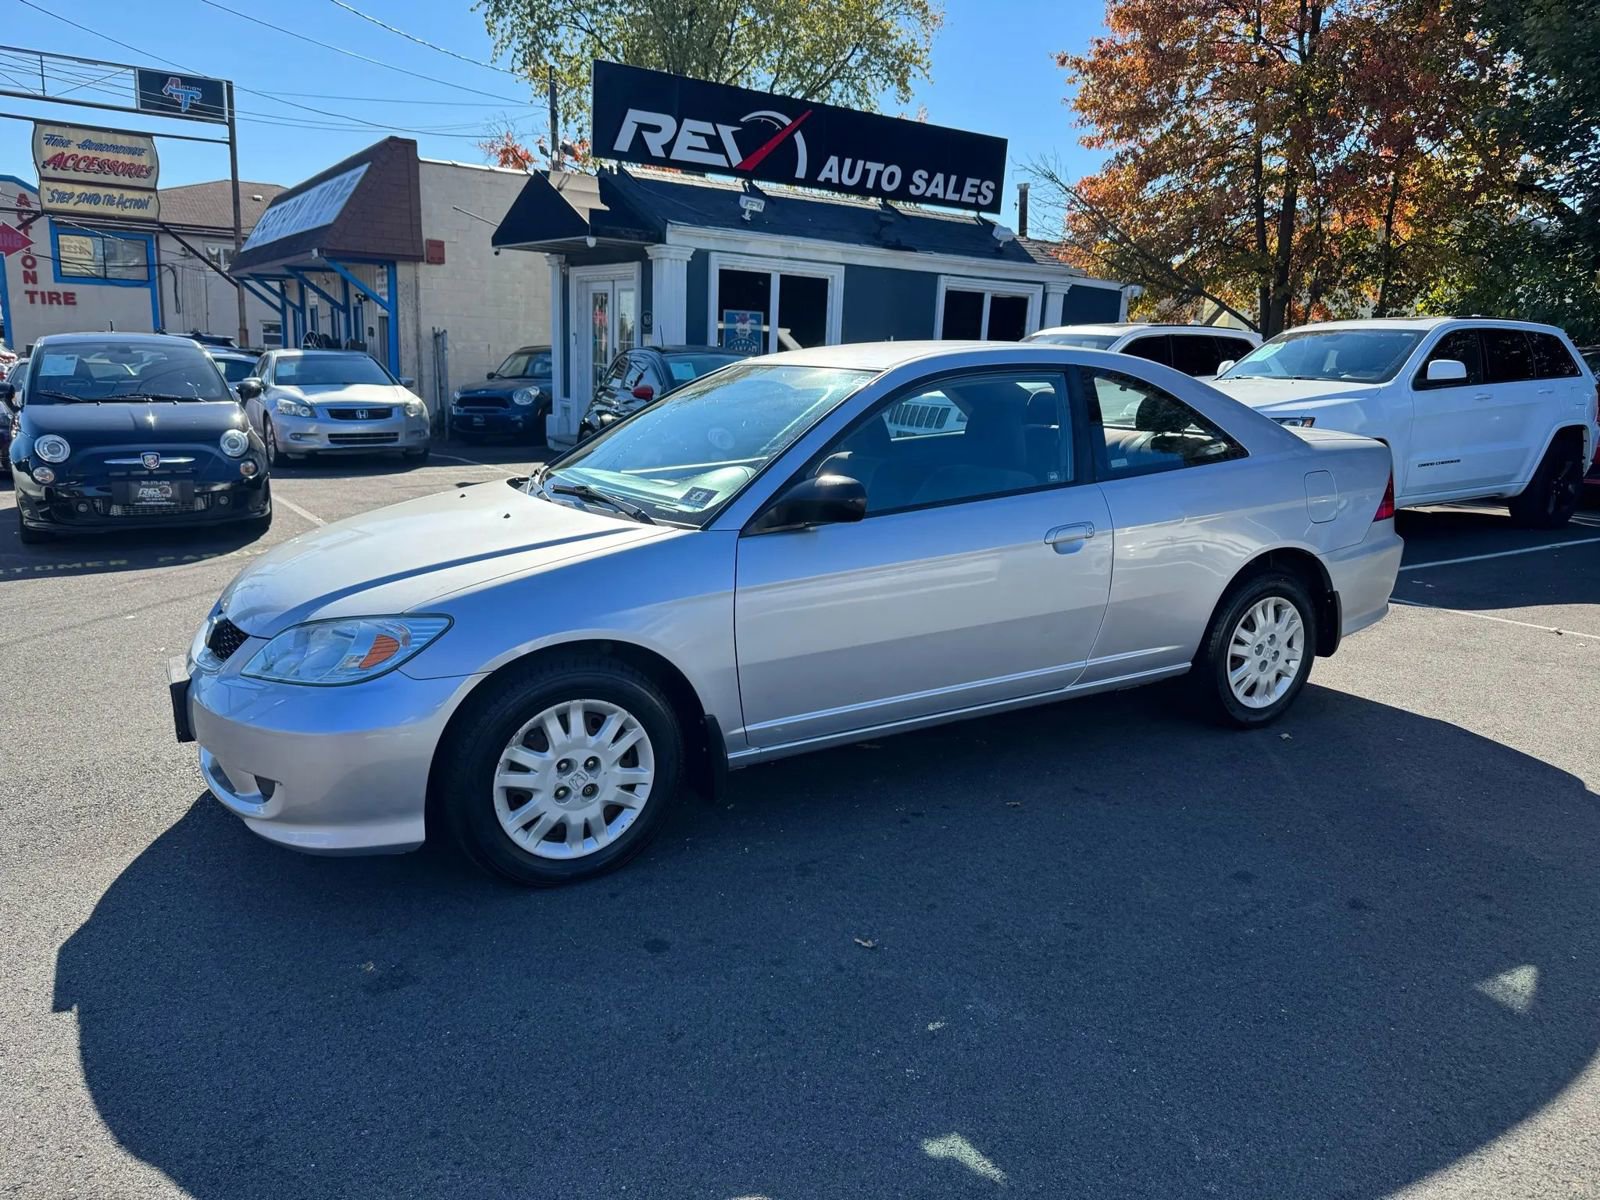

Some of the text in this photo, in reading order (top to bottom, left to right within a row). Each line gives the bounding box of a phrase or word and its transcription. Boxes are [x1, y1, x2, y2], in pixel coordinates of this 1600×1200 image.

[42, 151, 154, 179] ACCESSORIES
[817, 155, 902, 192] AUTO
[909, 169, 996, 206] SALES
[16, 193, 38, 285] ACTON
[25, 290, 77, 306] TIRE
